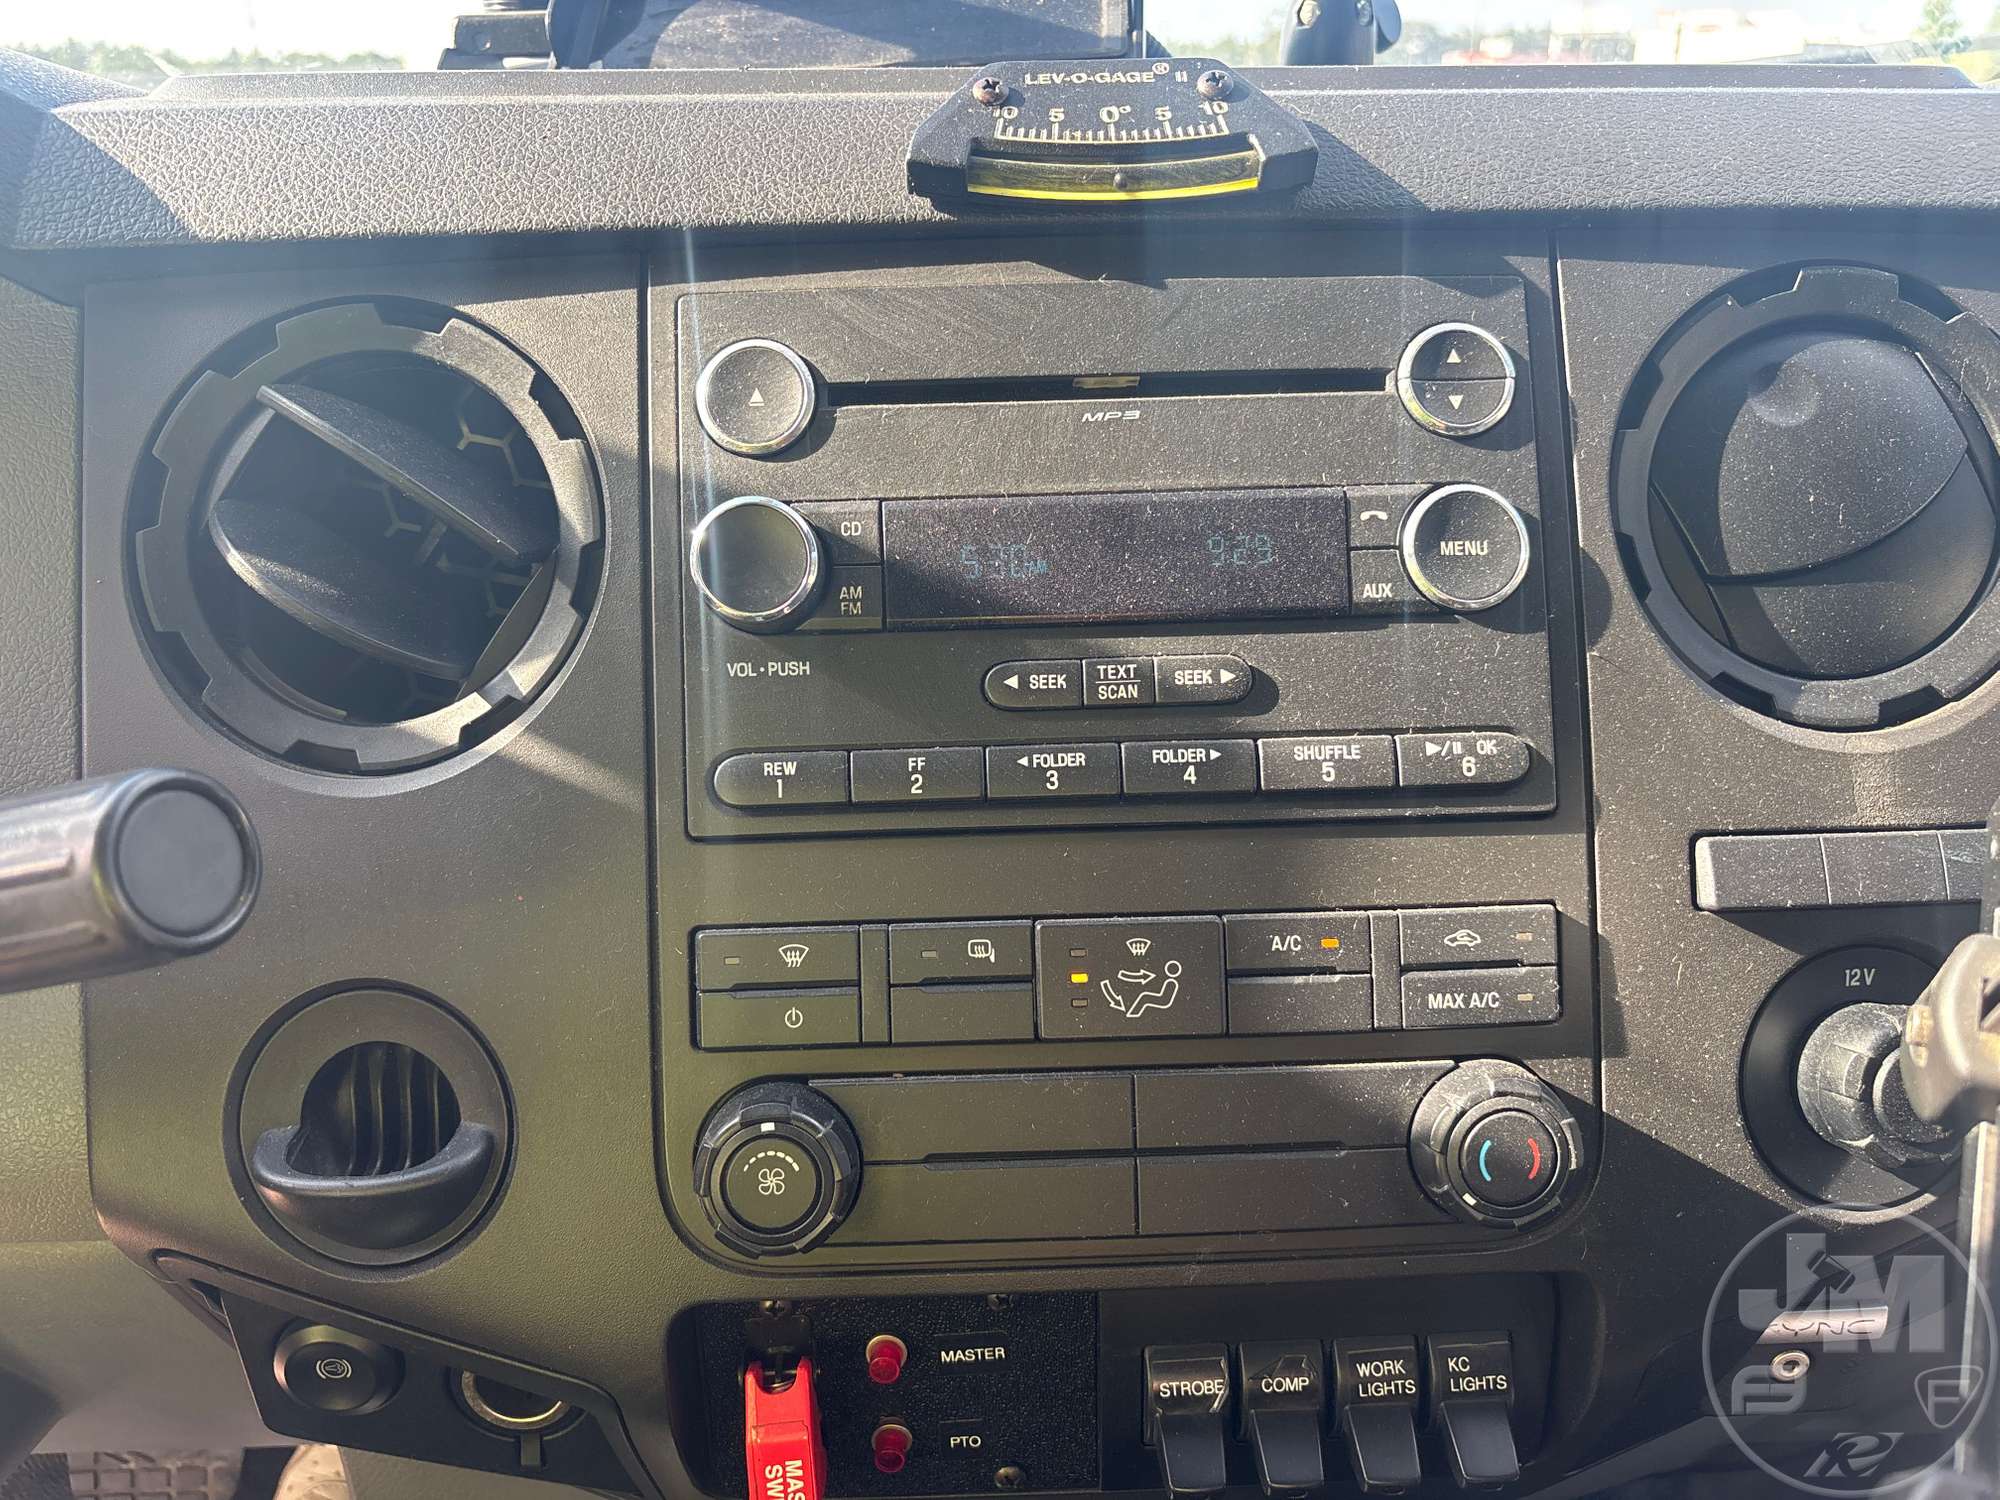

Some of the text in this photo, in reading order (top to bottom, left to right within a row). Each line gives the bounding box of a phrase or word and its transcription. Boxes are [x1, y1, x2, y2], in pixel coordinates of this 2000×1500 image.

[1048, 107, 1065, 122] 5
[1155, 106, 1172, 121] 5
[1081, 409, 1141, 423] MP3
[840, 521, 862, 537] CD
[1439, 540, 1490, 557] MENU
[839, 586, 863, 601] AM
[1362, 584, 1394, 600] AUX
[840, 602, 862, 617] FM
[1097, 664, 1138, 680] TEXT
[1174, 669, 1213, 685] SEEK
[1028, 674, 1067, 690] SEEK
[1098, 684, 1138, 700] SCAN
[1293, 745, 1361, 761] SHUFFLE
[1476, 739, 1500, 755] OK
[1032, 752, 1086, 768] FOLDER
[1152, 747, 1206, 764] FOLDER
[763, 762, 797, 776] REW
[908, 757, 926, 772] FF
[1321, 762, 1336, 782] 5
[1461, 757, 1476, 777] 6
[1045, 771, 1060, 790] 3
[1183, 765, 1198, 785] 4
[776, 779, 784, 799] 1
[910, 775, 924, 795] 2
[1271, 935, 1302, 951] A/C
[1845, 968, 1875, 987] 12V
[1428, 992, 1500, 1010] MAX A/C
[940, 1346, 1006, 1363] MASTER
[1356, 1360, 1406, 1378] WORK
[1448, 1357, 1471, 1373] KC
[1159, 1380, 1225, 1397] STROBE
[1261, 1377, 1310, 1393] COMP
[1358, 1380, 1416, 1397] LIGHTS
[1450, 1375, 1508, 1393] LIGHTS
[949, 1436, 983, 1450] PTO
